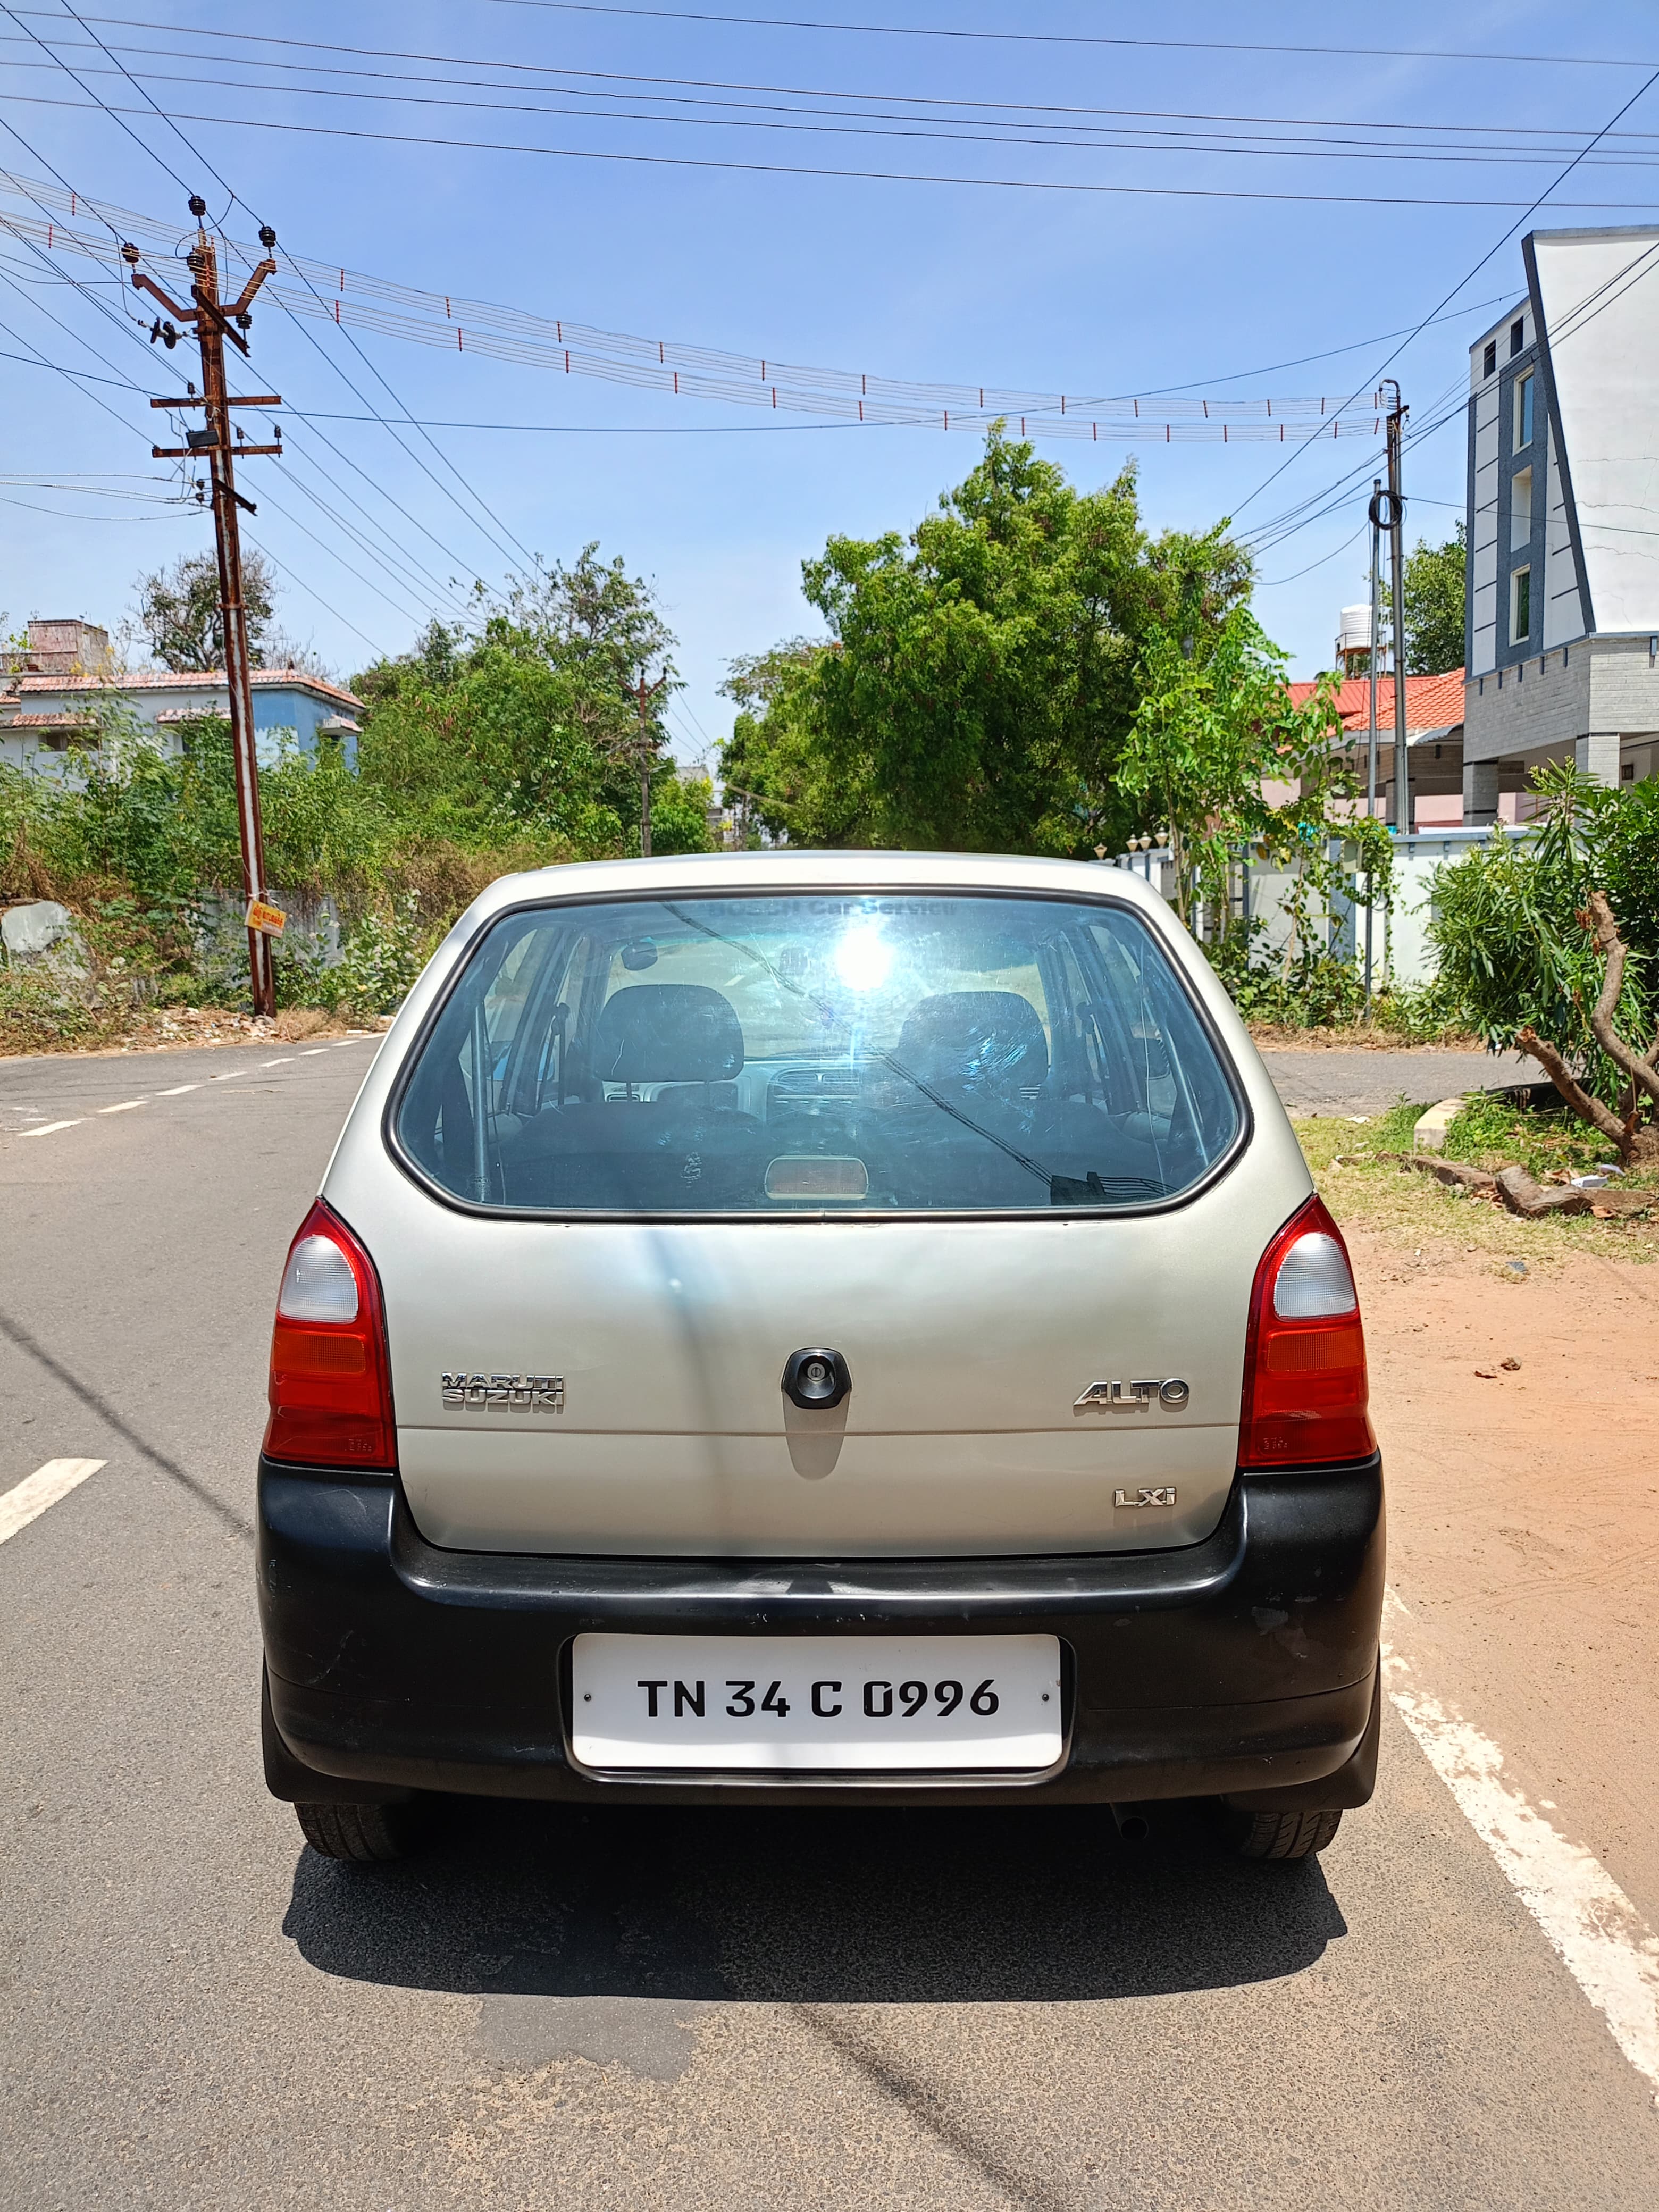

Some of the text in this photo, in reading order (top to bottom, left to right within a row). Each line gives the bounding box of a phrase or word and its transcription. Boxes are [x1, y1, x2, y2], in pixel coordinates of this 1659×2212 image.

[808, 901, 852, 915] Car
[442, 1372, 564, 1389] MARUTI
[442, 1388, 564, 1405] SUZUKI
[1073, 1378, 1190, 1406] ALTO
[1114, 1487, 1176, 1507] LXi
[638, 1679, 1000, 1717] TN 34 C 0996
